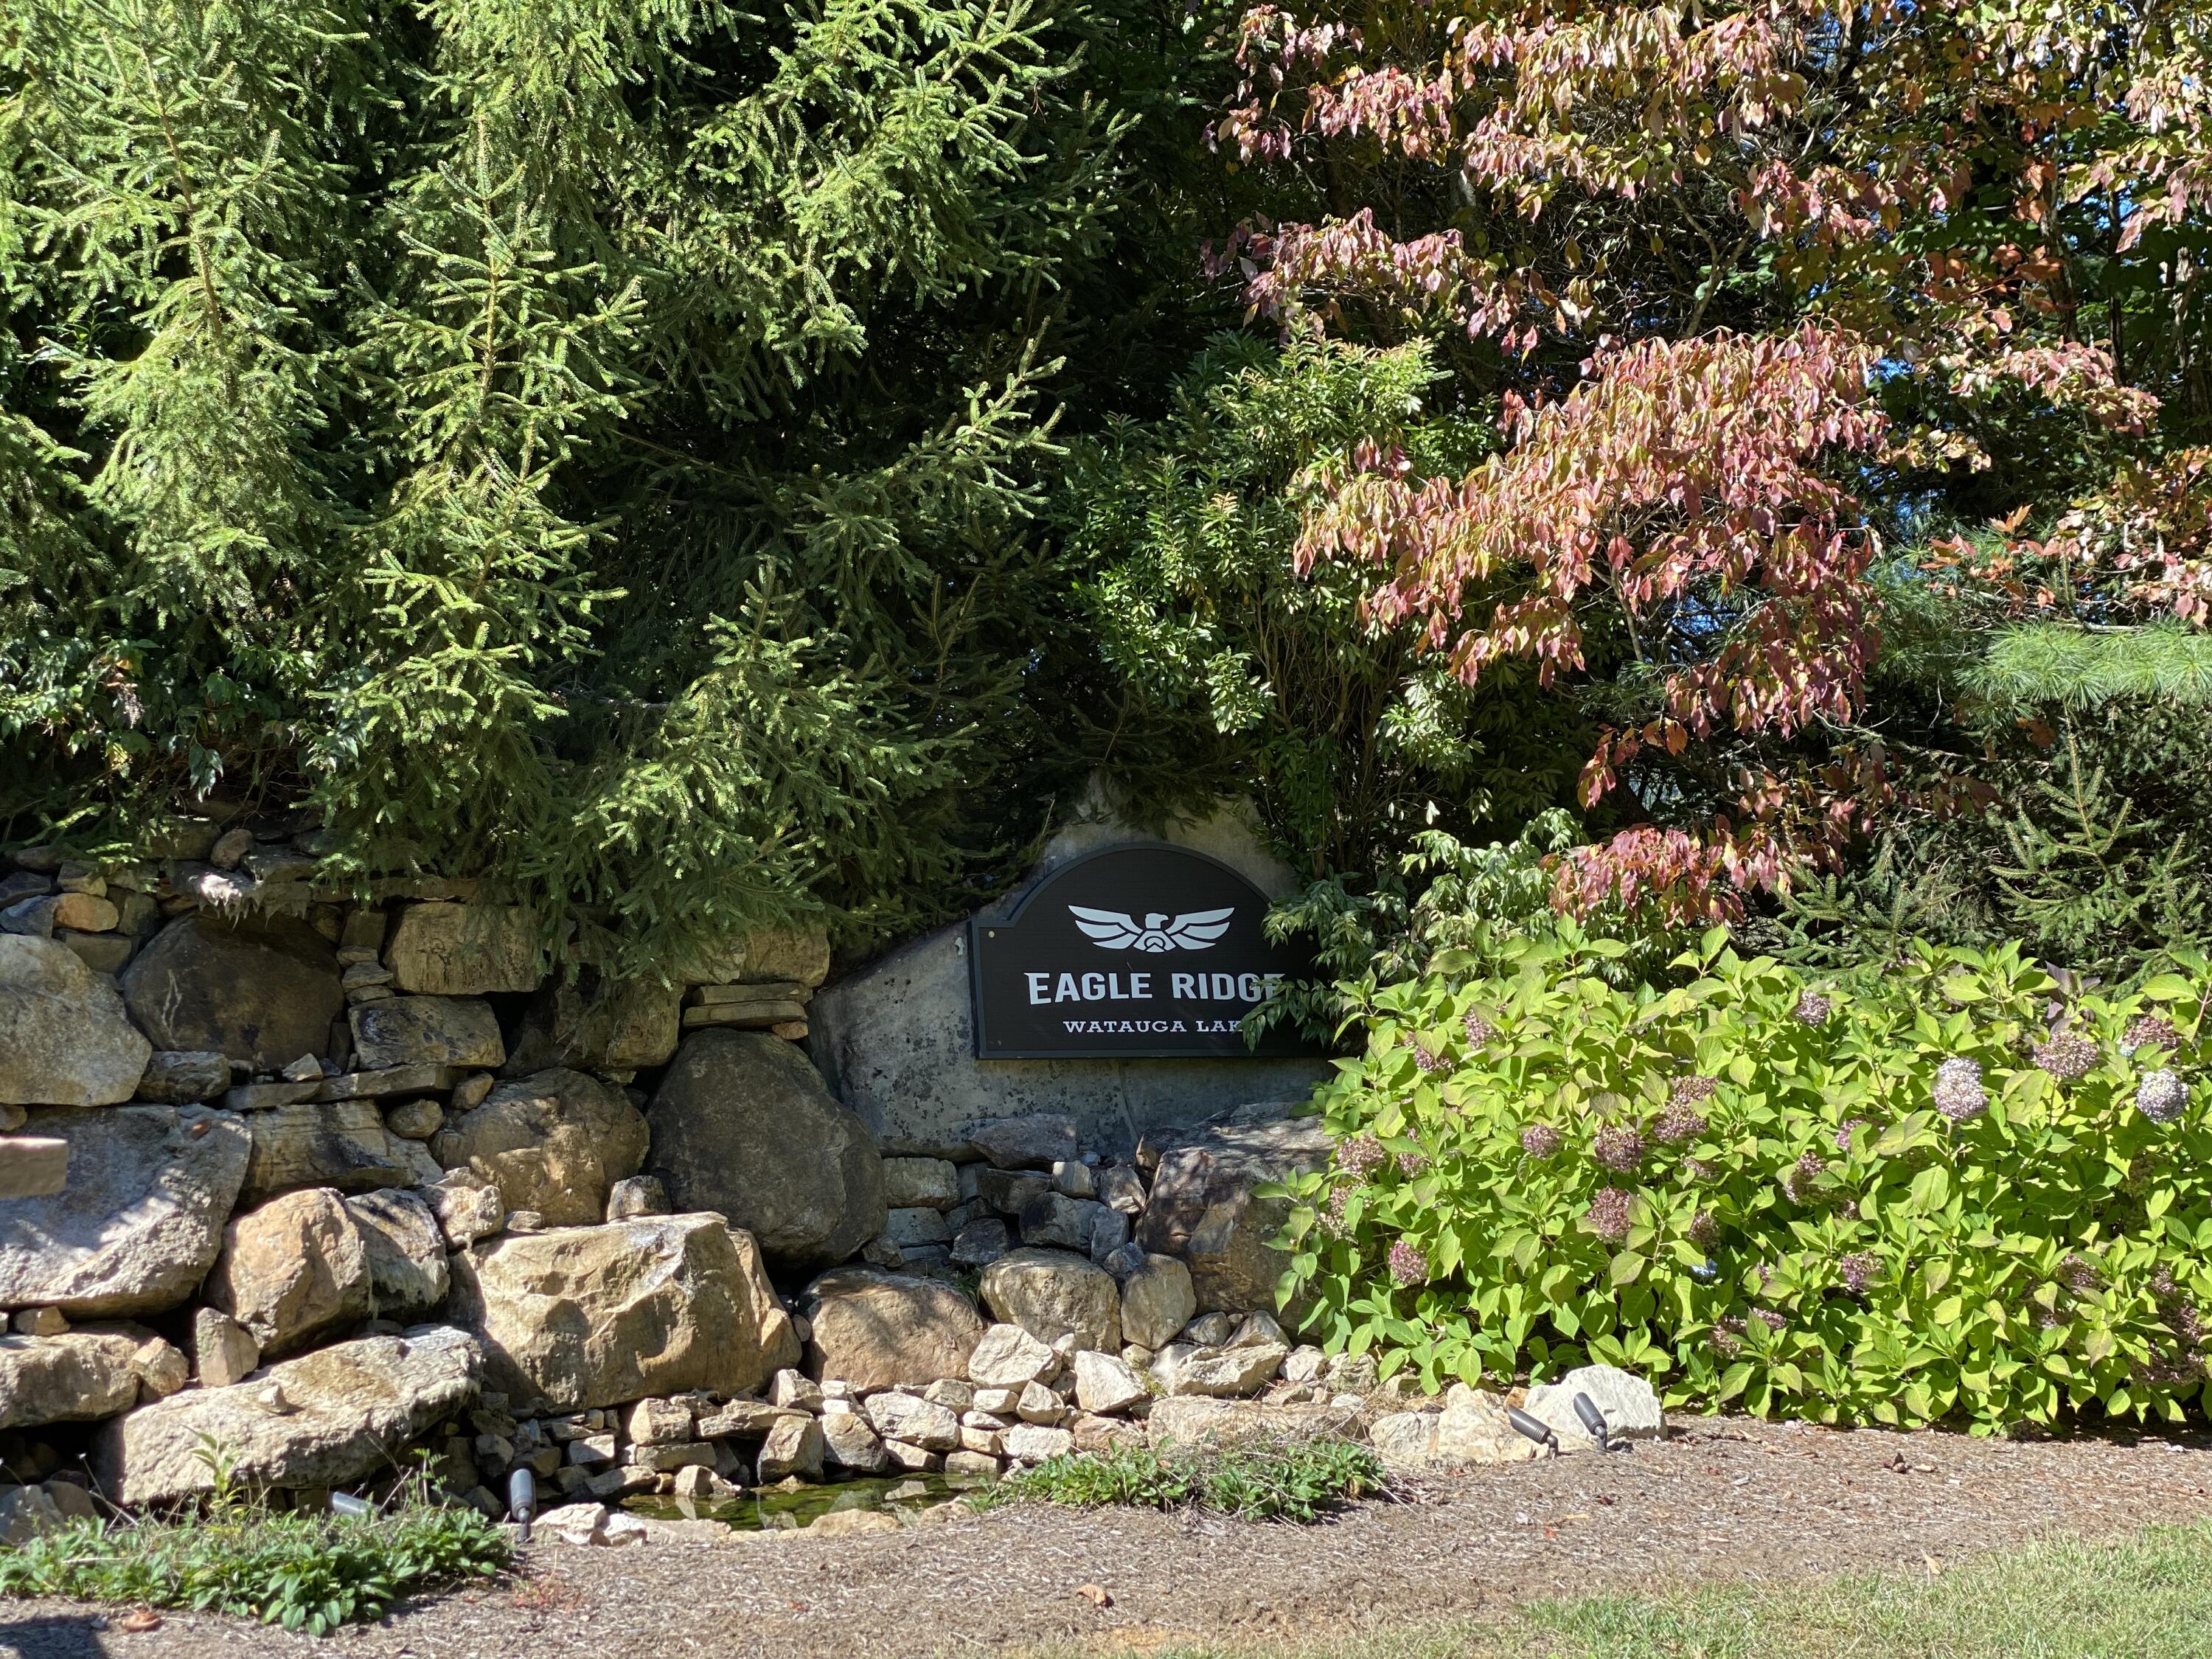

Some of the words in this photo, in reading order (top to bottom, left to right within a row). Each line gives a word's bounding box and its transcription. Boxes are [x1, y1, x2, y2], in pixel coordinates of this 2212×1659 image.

[1023, 973, 1152, 1004] EAGLE
[1062, 1020, 1187, 1032] WATAUGA
[1195, 1020, 1243, 1032] LAK
